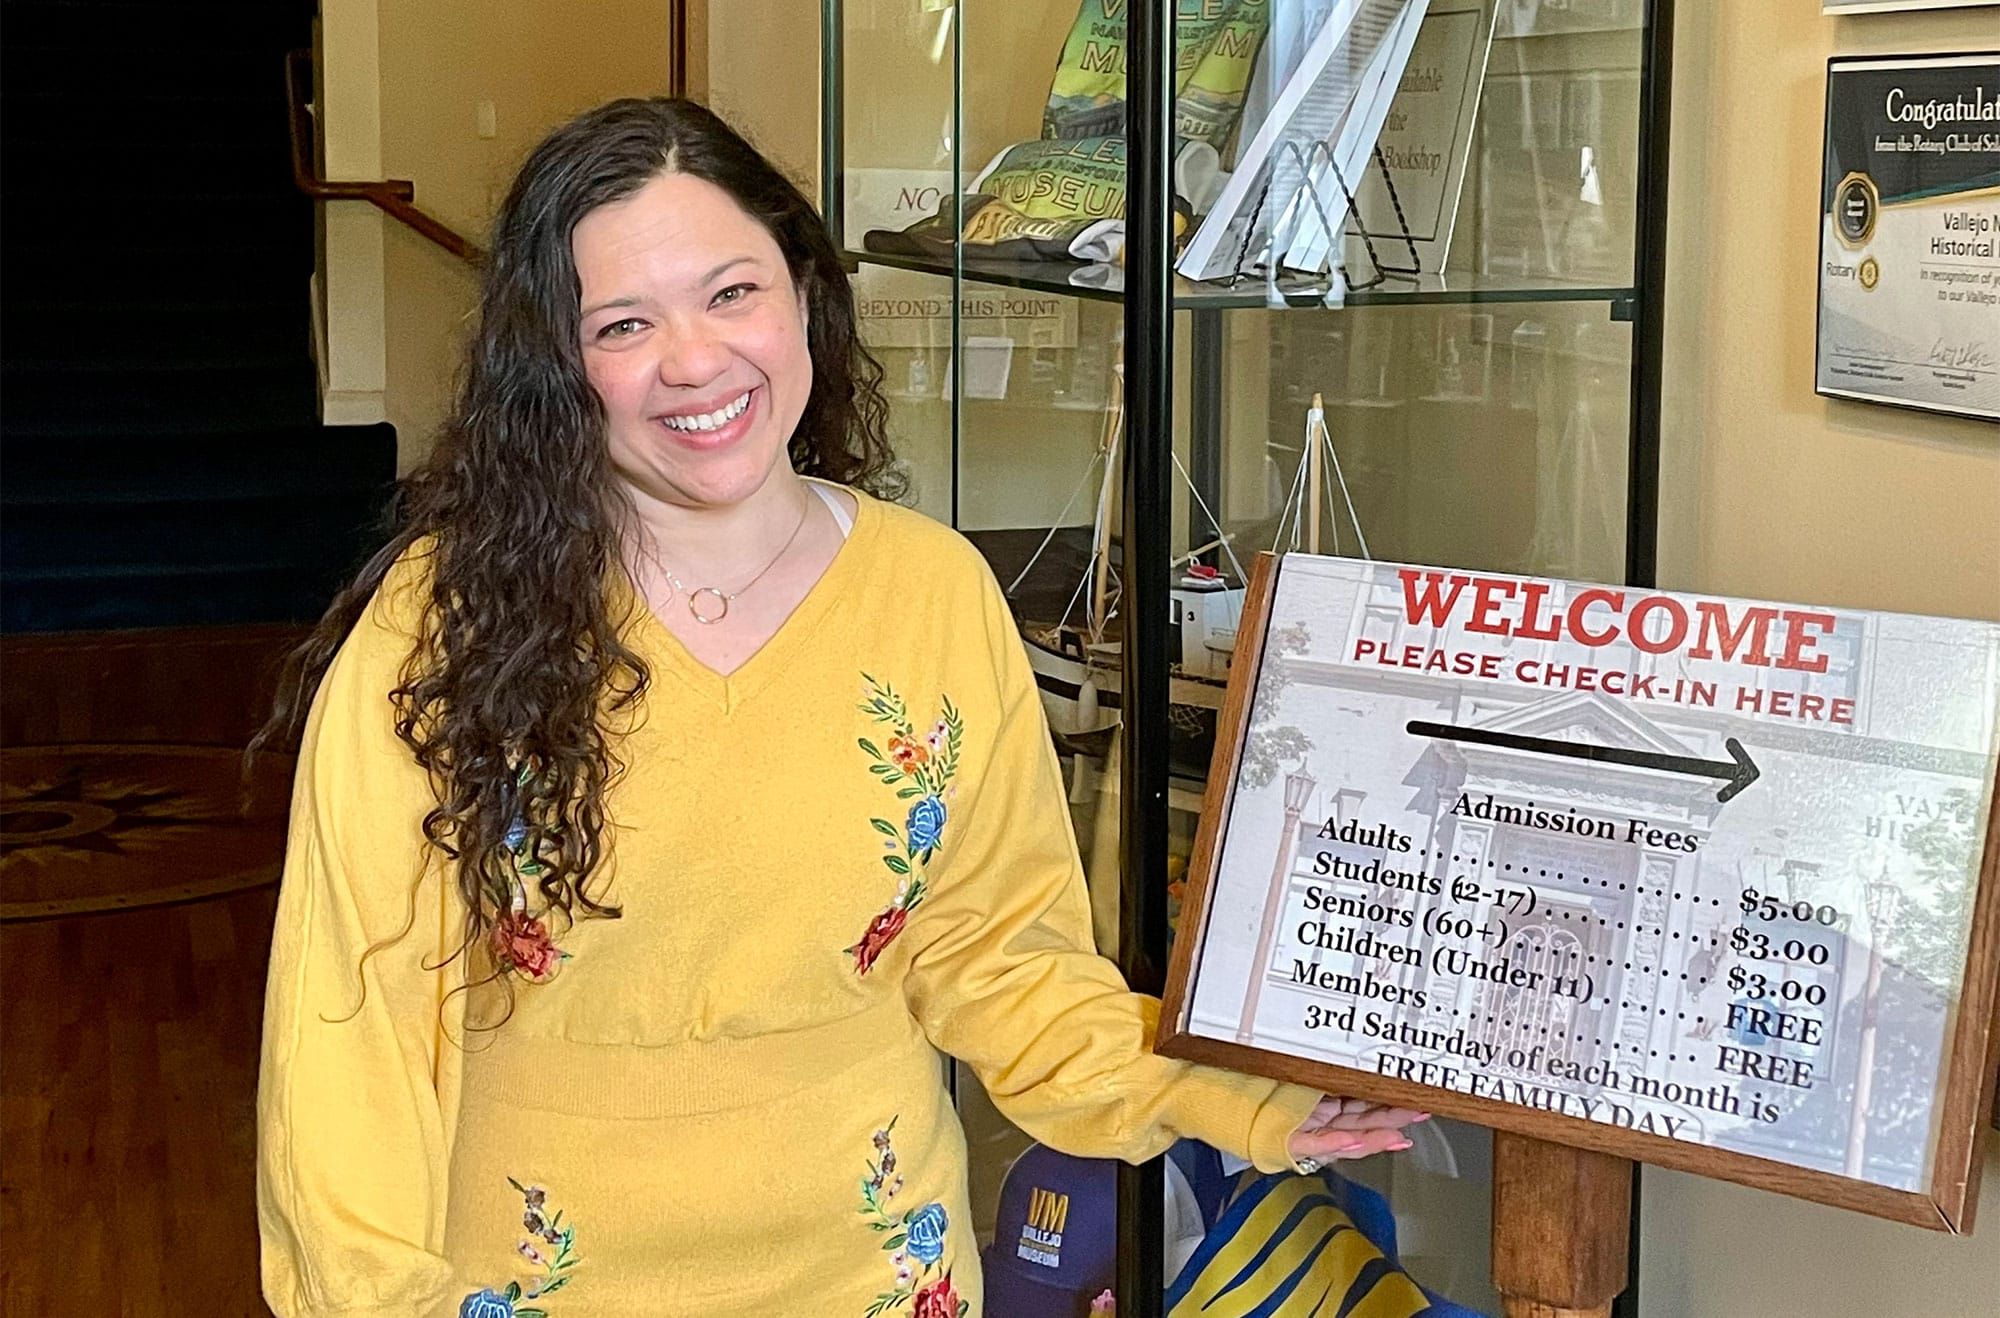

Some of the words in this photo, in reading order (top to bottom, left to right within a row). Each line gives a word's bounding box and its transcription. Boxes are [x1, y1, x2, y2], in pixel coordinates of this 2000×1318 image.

[1931, 237, 1994, 257] Historical
[1943, 212, 1989, 235] Vallejo
[861, 300, 941, 316] BEYOND
[950, 300, 993, 316] HIS
[1001, 300, 1061, 315] POINT
[1826, 262, 1856, 280] Rotary
[1398, 569, 1836, 673] WELCOME
[1353, 639, 1501, 679] PLEASE
[1515, 660, 1718, 707] CHECK-IN
[1736, 687, 1856, 724] HERE
[1450, 792, 1615, 841] Admission
[1624, 818, 1698, 853] Fees
[1313, 851, 1443, 896] Students
[1730, 924, 1829, 965] $3.00
[1317, 817, 1412, 853] Adults
[1739, 886, 1838, 926] $5.00
[1298, 921, 1422, 967] Children
[1433, 946, 1543, 991] (Under
[1552, 973, 1594, 1004] 11)
[1724, 1003, 1823, 1046] FREE
[1303, 886, 1415, 928] Seniors
[1423, 907, 1508, 949] (60+)
[1727, 964, 1826, 1006] $3.00
[1290, 959, 1427, 1009] Members
[1715, 1045, 1814, 1089] FREE
[1304, 1005, 1356, 1033] 3rd
[1362, 1012, 1500, 1068] Saturday
[1508, 1046, 1545, 1076] of
[1547, 1057, 1620, 1090] each
[1629, 1073, 1740, 1115] month
[1749, 1092, 1780, 1124] is
[1376, 1052, 1460, 1095] FREE
[1470, 1072, 1603, 1122] FAMILY
[1611, 1103, 1687, 1140] DAY
[1027, 1186, 1069, 1234] VM
